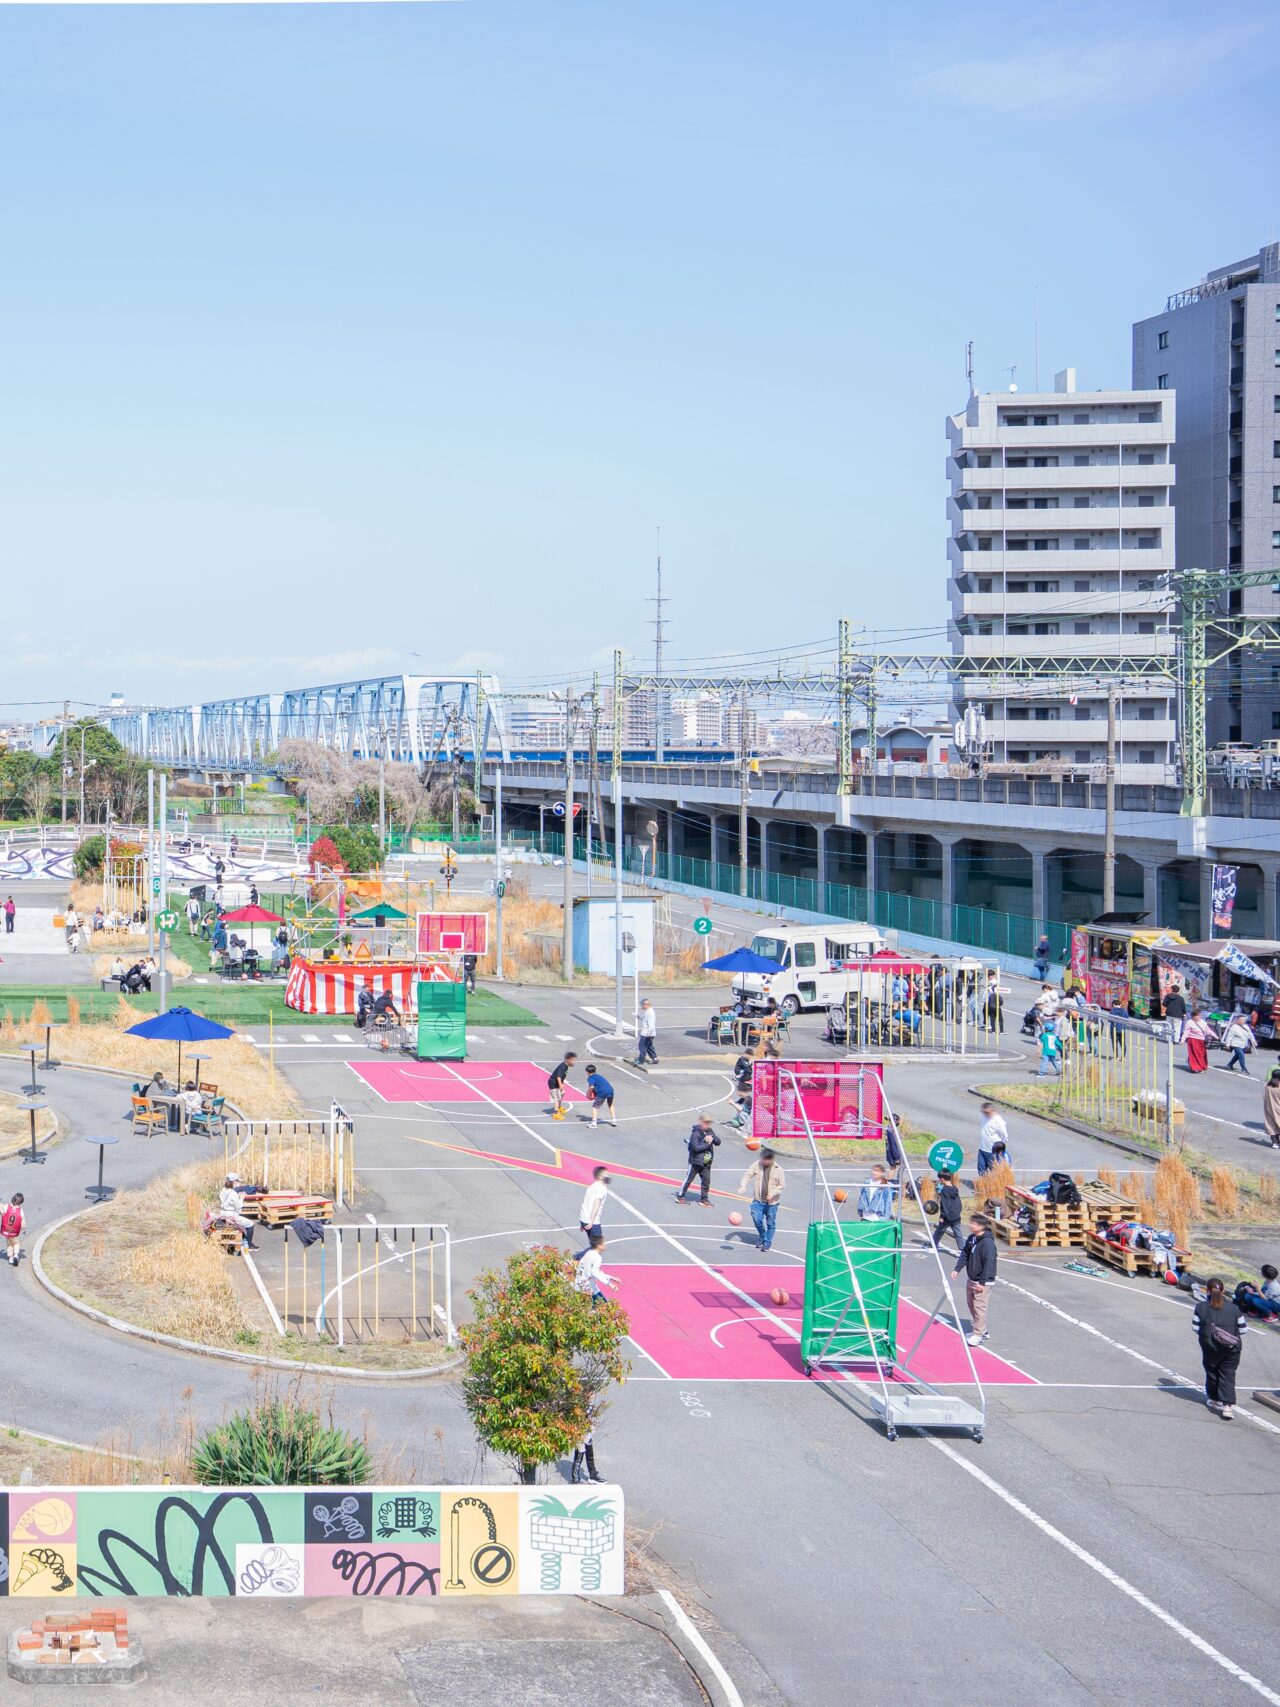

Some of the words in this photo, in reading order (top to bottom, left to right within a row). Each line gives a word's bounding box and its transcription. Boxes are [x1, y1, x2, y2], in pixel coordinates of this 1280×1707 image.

[160, 913, 175, 929] 17
[699, 920, 707, 931] 2
[8, 1215, 16, 1226] 9
